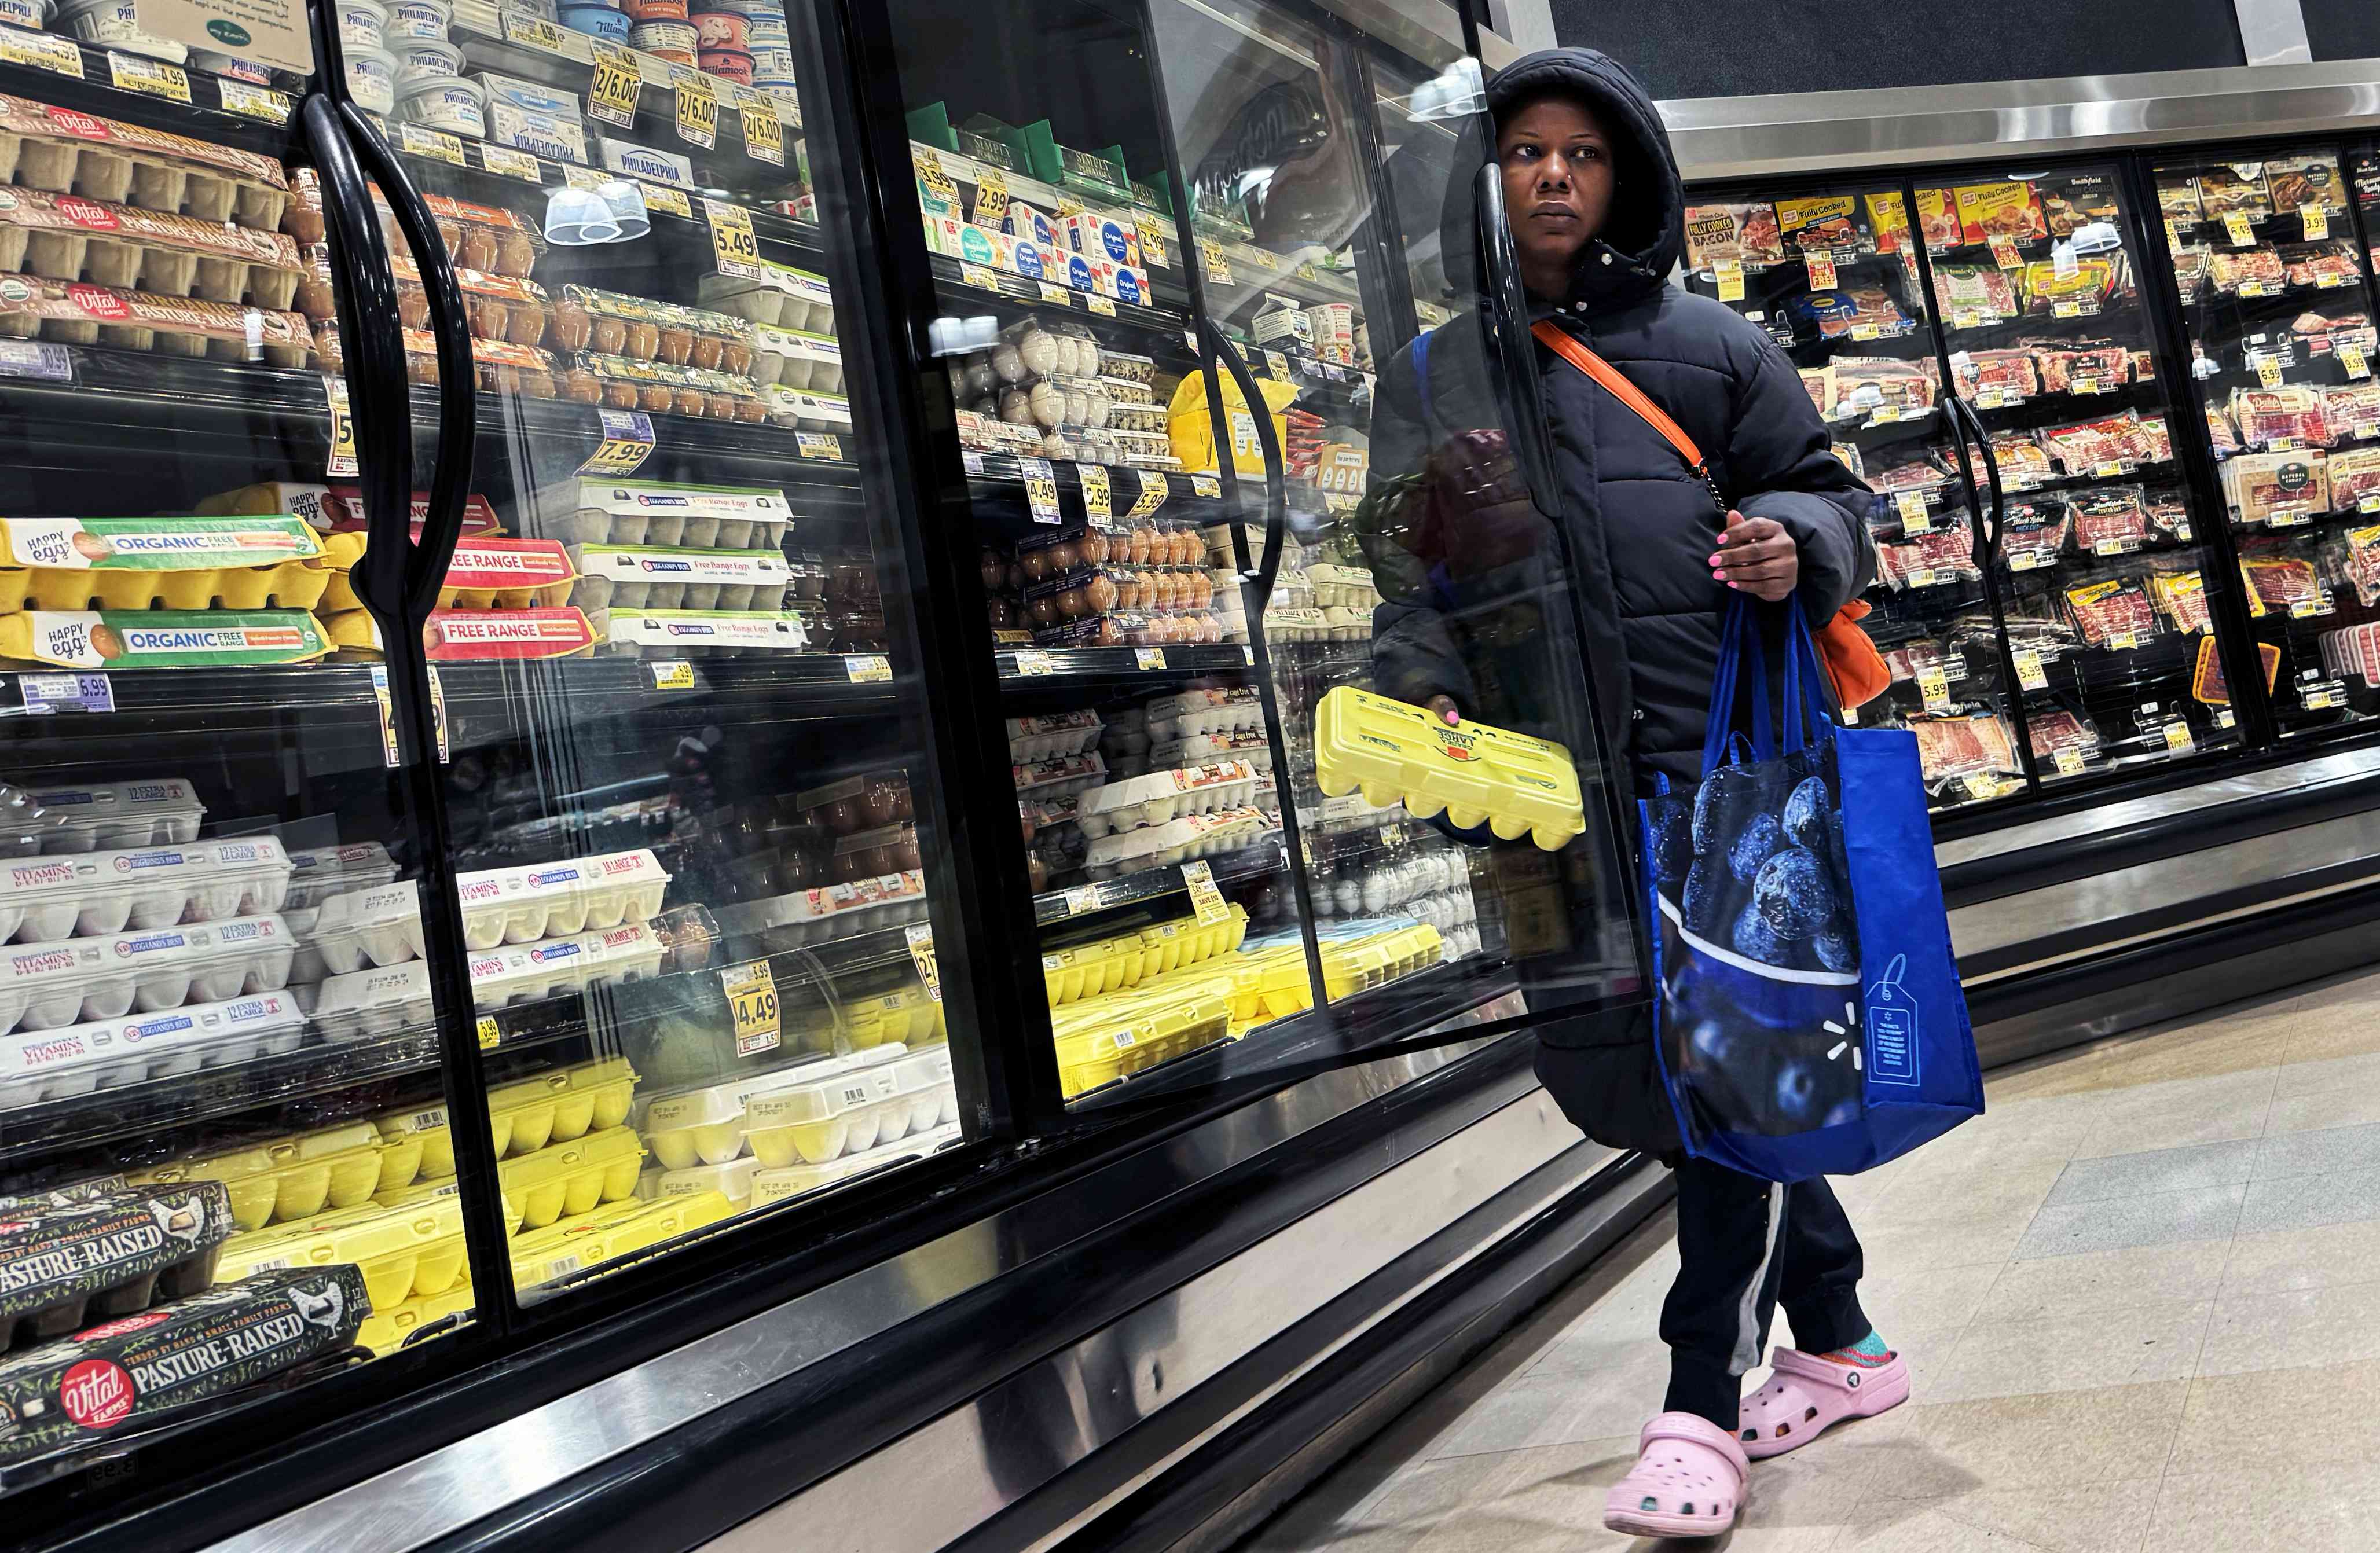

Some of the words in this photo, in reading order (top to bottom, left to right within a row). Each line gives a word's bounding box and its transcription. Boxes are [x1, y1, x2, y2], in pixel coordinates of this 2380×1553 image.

[398, 9, 443, 25] PHILADELPHIA
[161, 68, 185, 87] 4.99
[595, 68, 638, 103] 2/6.00
[679, 92, 716, 123] 2/6.00
[54, 113, 100, 130] Vital
[746, 116, 780, 142] 2/6.00
[514, 133, 575, 161] PHILADELPHIA
[620, 155, 681, 182] PHILADELPHIA
[919, 166, 951, 189] 3.99
[979, 188, 1006, 212] 2.99
[1977, 190, 1996, 201] Fully
[1995, 182, 2021, 196] Cooked
[63, 204, 109, 221] Vital
[1799, 207, 1818, 219] Fully
[1818, 200, 1847, 213] Cooked
[1688, 221, 1707, 235] FULLY
[1707, 217, 1733, 232] COOKED
[2305, 217, 2326, 229] 3.99
[715, 229, 754, 256] 5.49
[1105, 232, 1124, 244] Original
[1693, 231, 1735, 247] BACON
[1018, 252, 1039, 265] Original
[2000, 255, 2020, 265] FREE
[1071, 268, 1090, 278] Original
[1813, 274, 1836, 285] FREE
[1119, 279, 1137, 290] Original
[75, 292, 120, 309] Vital
[141, 293, 237, 315] ORGANIC
[41, 347, 68, 370] 10.99
[2345, 358, 2365, 369] 9.99
[2261, 369, 2281, 380] 6.99
[599, 442, 647, 462] 7.99
[290, 492, 317, 508] HAPPY
[1030, 483, 1055, 500] 4.49
[1136, 494, 1165, 508] 5.99
[27, 530, 65, 550] HAPPY
[116, 536, 209, 550] ORGANIC
[207, 536, 233, 544] FREE
[32, 542, 69, 563] egg
[474, 553, 520, 568] RANGE
[49, 623, 83, 643] HAPPY
[449, 623, 484, 638] FREE
[488, 623, 537, 638] RANGE
[52, 636, 86, 660] egg
[130, 632, 218, 649] ORGANIC
[217, 632, 243, 641] FREE
[219, 639, 245, 647] RANGE
[2018, 665, 2041, 678] 5.99
[80, 678, 108, 698] 6.99
[1924, 683, 1946, 697] 5.99
[611, 857, 630, 869] LARGE
[13, 865, 72, 880] VITAMINS
[220, 927, 231, 940] 12
[230, 923, 256, 933] EXTRA
[231, 928, 259, 938] LARGE
[611, 930, 631, 943] LARGE
[166, 936, 183, 948] BEST
[13, 952, 74, 970] VITAMINS
[228, 1005, 238, 1020] 12
[237, 1001, 263, 1011] EXTRA
[238, 1006, 265, 1016] LARGE
[738, 993, 776, 1026] 4.49
[141, 1021, 175, 1036] EGGLAND'S
[175, 1018, 191, 1030] BEST
[480, 1020, 497, 1038] 5.99
[23, 1039, 84, 1058] VITAMINS
[91, 1222, 122, 1235] FAMILY
[122, 1214, 152, 1227] FARMS
[352, 1288, 364, 1299] 12
[123, 1349, 159, 1366] TENDED
[159, 1343, 172, 1353] BY
[173, 1334, 196, 1351] HAND
[204, 1322, 232, 1338] SMALL
[233, 1312, 263, 1330] FAMILY
[263, 1301, 293, 1319] FARMS
[130, 1312, 305, 1394] PASTURE-RAISED
[65, 1365, 124, 1419] Vital
